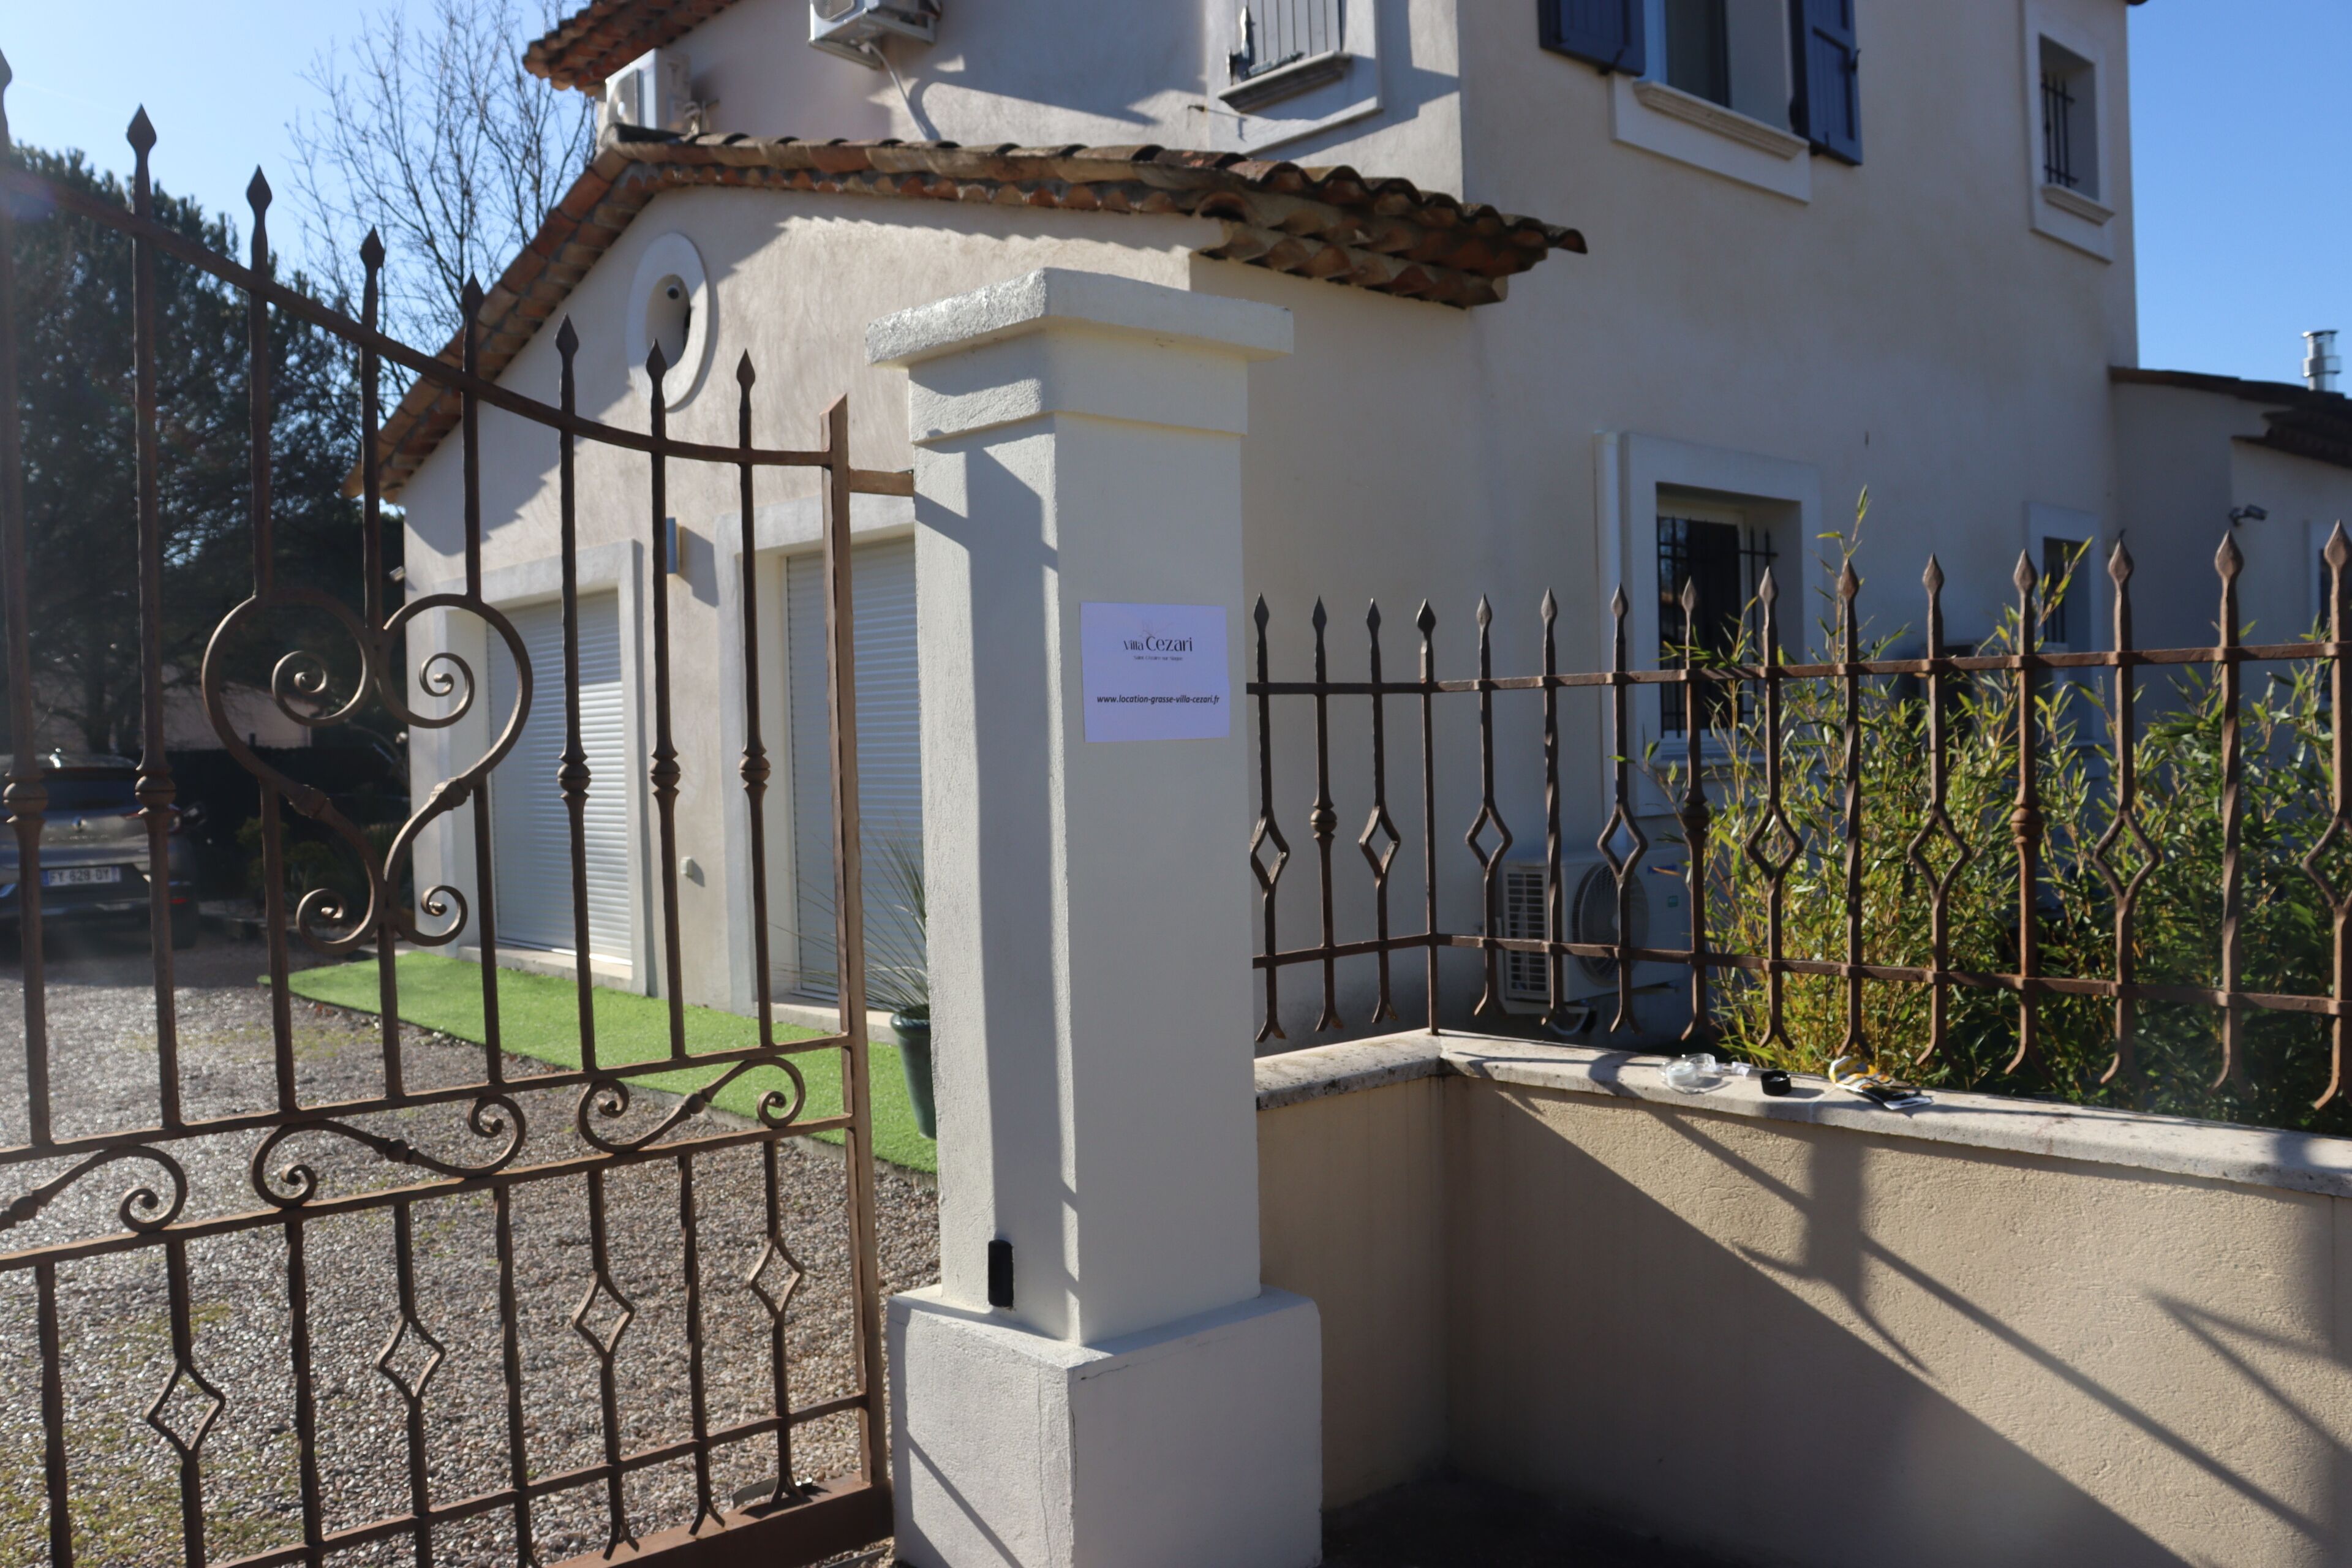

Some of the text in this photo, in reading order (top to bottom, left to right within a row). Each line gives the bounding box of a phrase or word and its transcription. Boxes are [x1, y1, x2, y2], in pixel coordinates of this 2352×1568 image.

[1123, 636, 1193, 652] Villa Cezari
[1097, 695, 1220, 705] www.location-grasse-villa-cezari.fr
